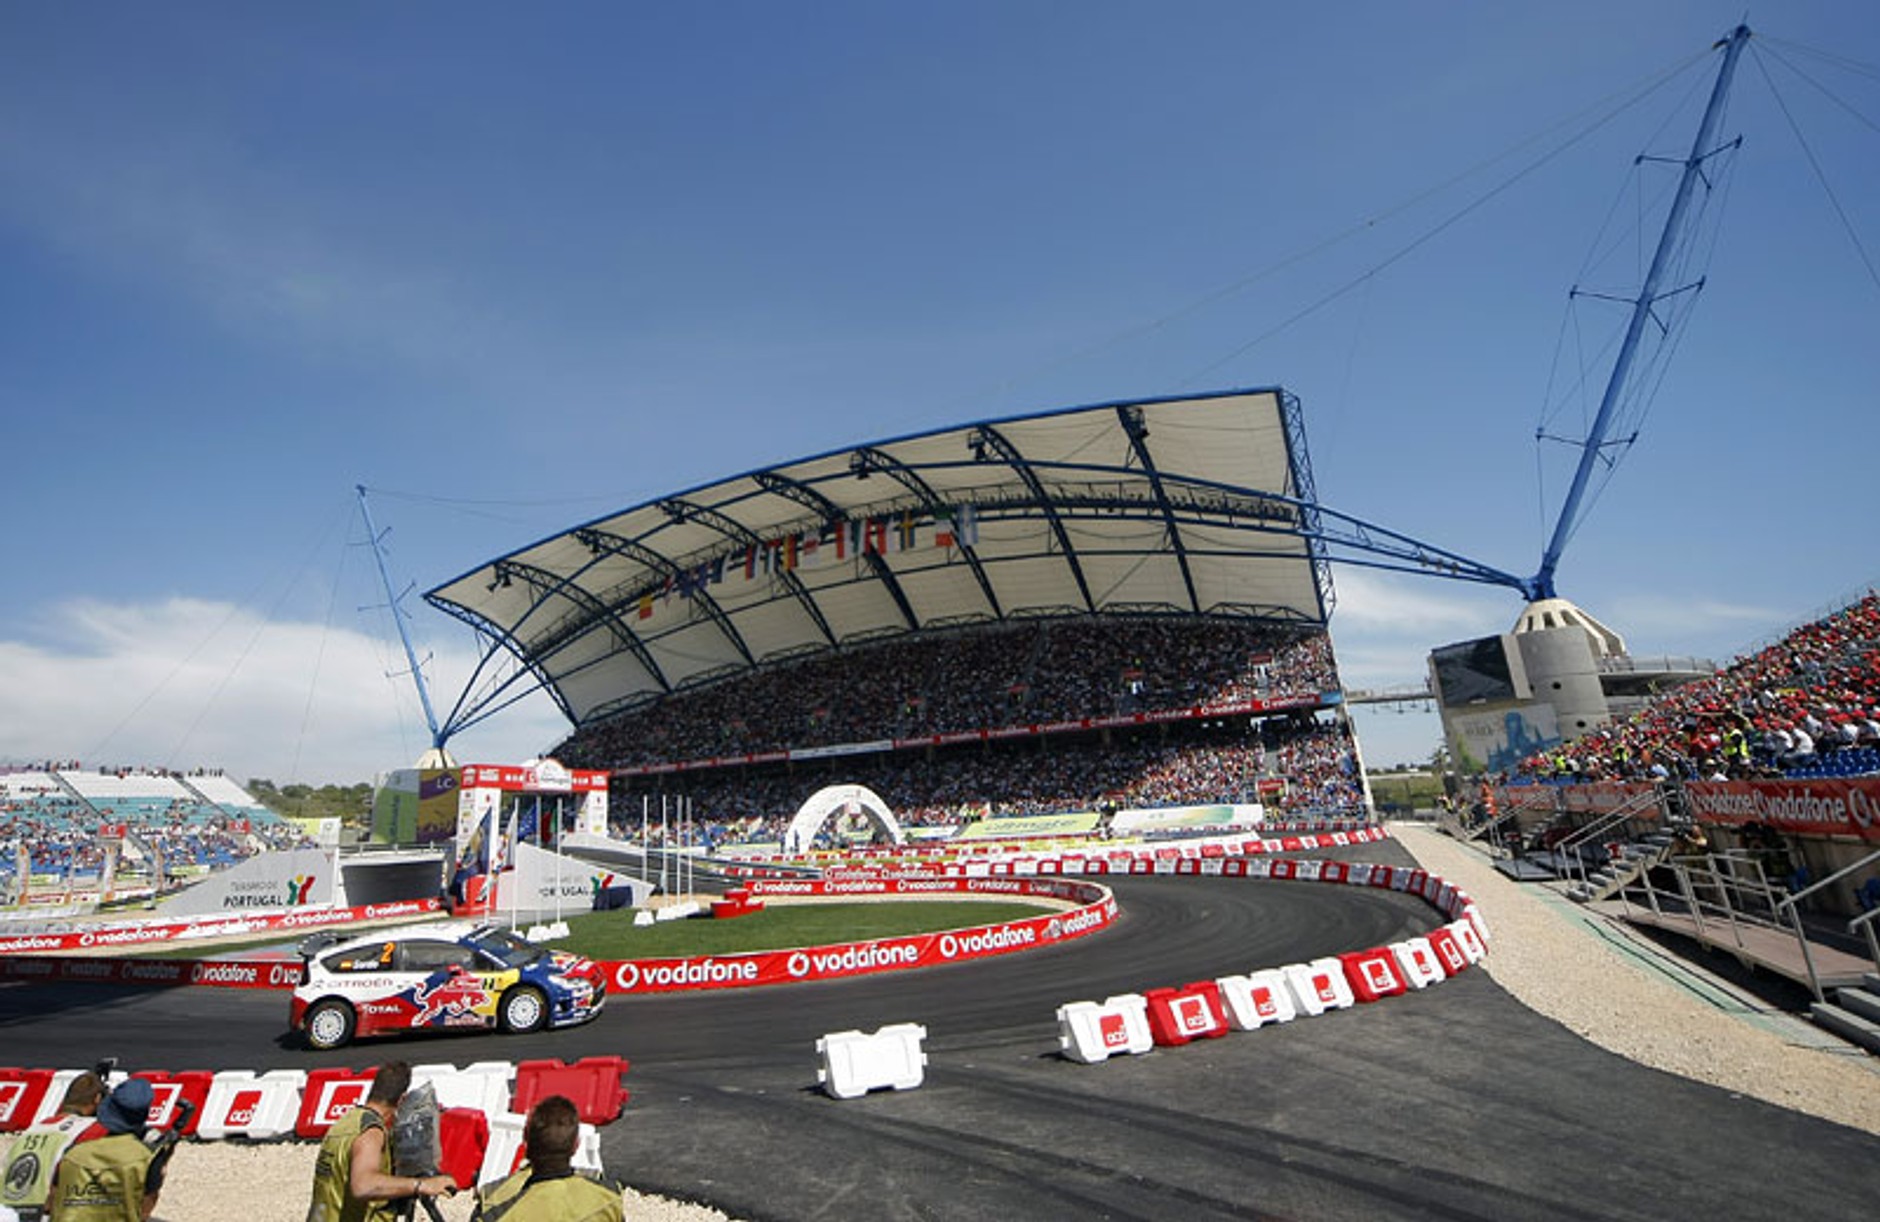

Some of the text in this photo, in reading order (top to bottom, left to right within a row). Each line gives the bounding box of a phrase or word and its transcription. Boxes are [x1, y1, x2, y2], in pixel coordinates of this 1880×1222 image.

[1769, 786, 1849, 822] vodafone
[224, 895, 283, 908] PORTUGAL
[958, 925, 1036, 950] vodafone
[380, 942, 397, 963] 2
[813, 944, 918, 972] vodafone
[202, 962, 258, 983] vodafone
[642, 958, 758, 985] vodafone
